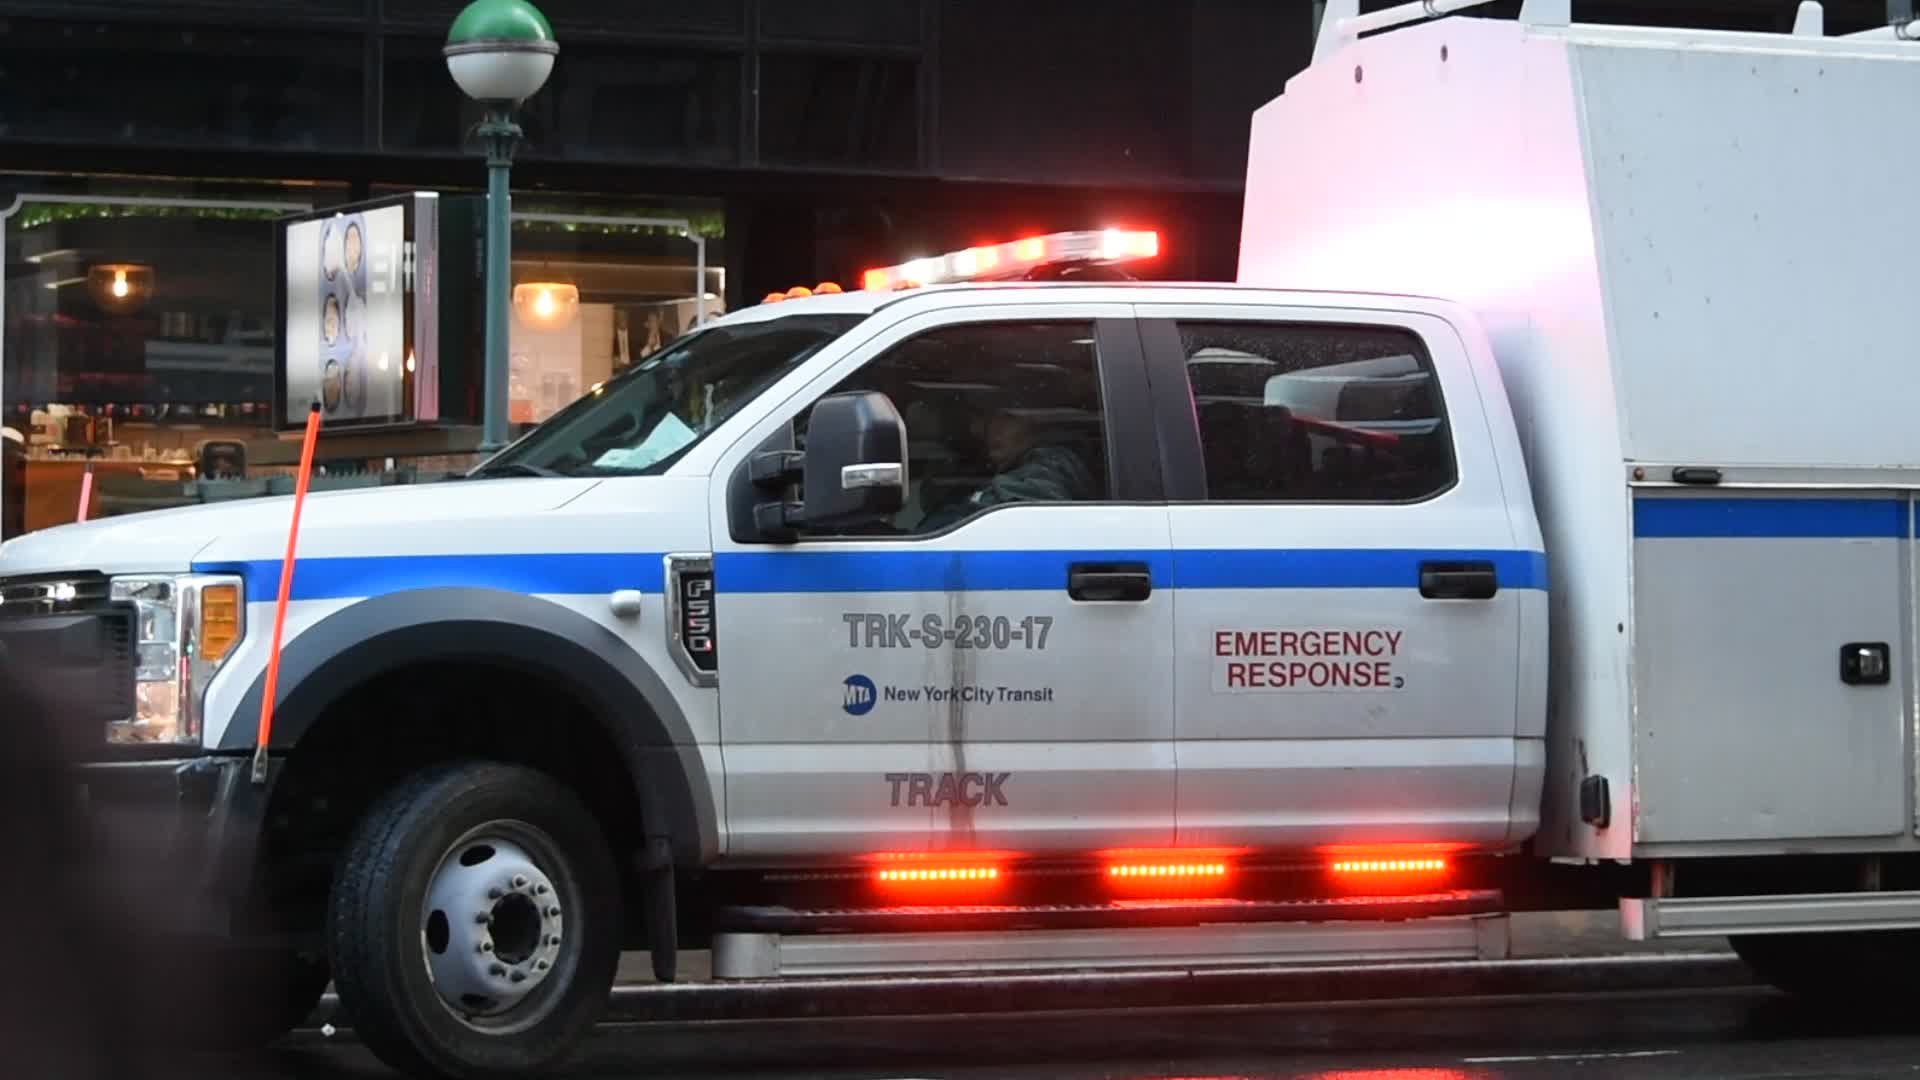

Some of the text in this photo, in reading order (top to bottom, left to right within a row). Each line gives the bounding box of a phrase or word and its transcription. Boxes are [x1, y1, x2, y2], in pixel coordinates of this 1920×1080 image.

[687, 580, 712, 651] F550
[843, 614, 1053, 649] TRK-S-230-17
[1215, 631, 1402, 656] EMERGENCY
[1228, 662, 1391, 687] RESPONSE
[884, 686, 920, 701] New
[923, 686, 960, 701] York
[962, 686, 993, 705] City
[997, 686, 1053, 702] Transit
[885, 772, 1011, 807] TRACK
